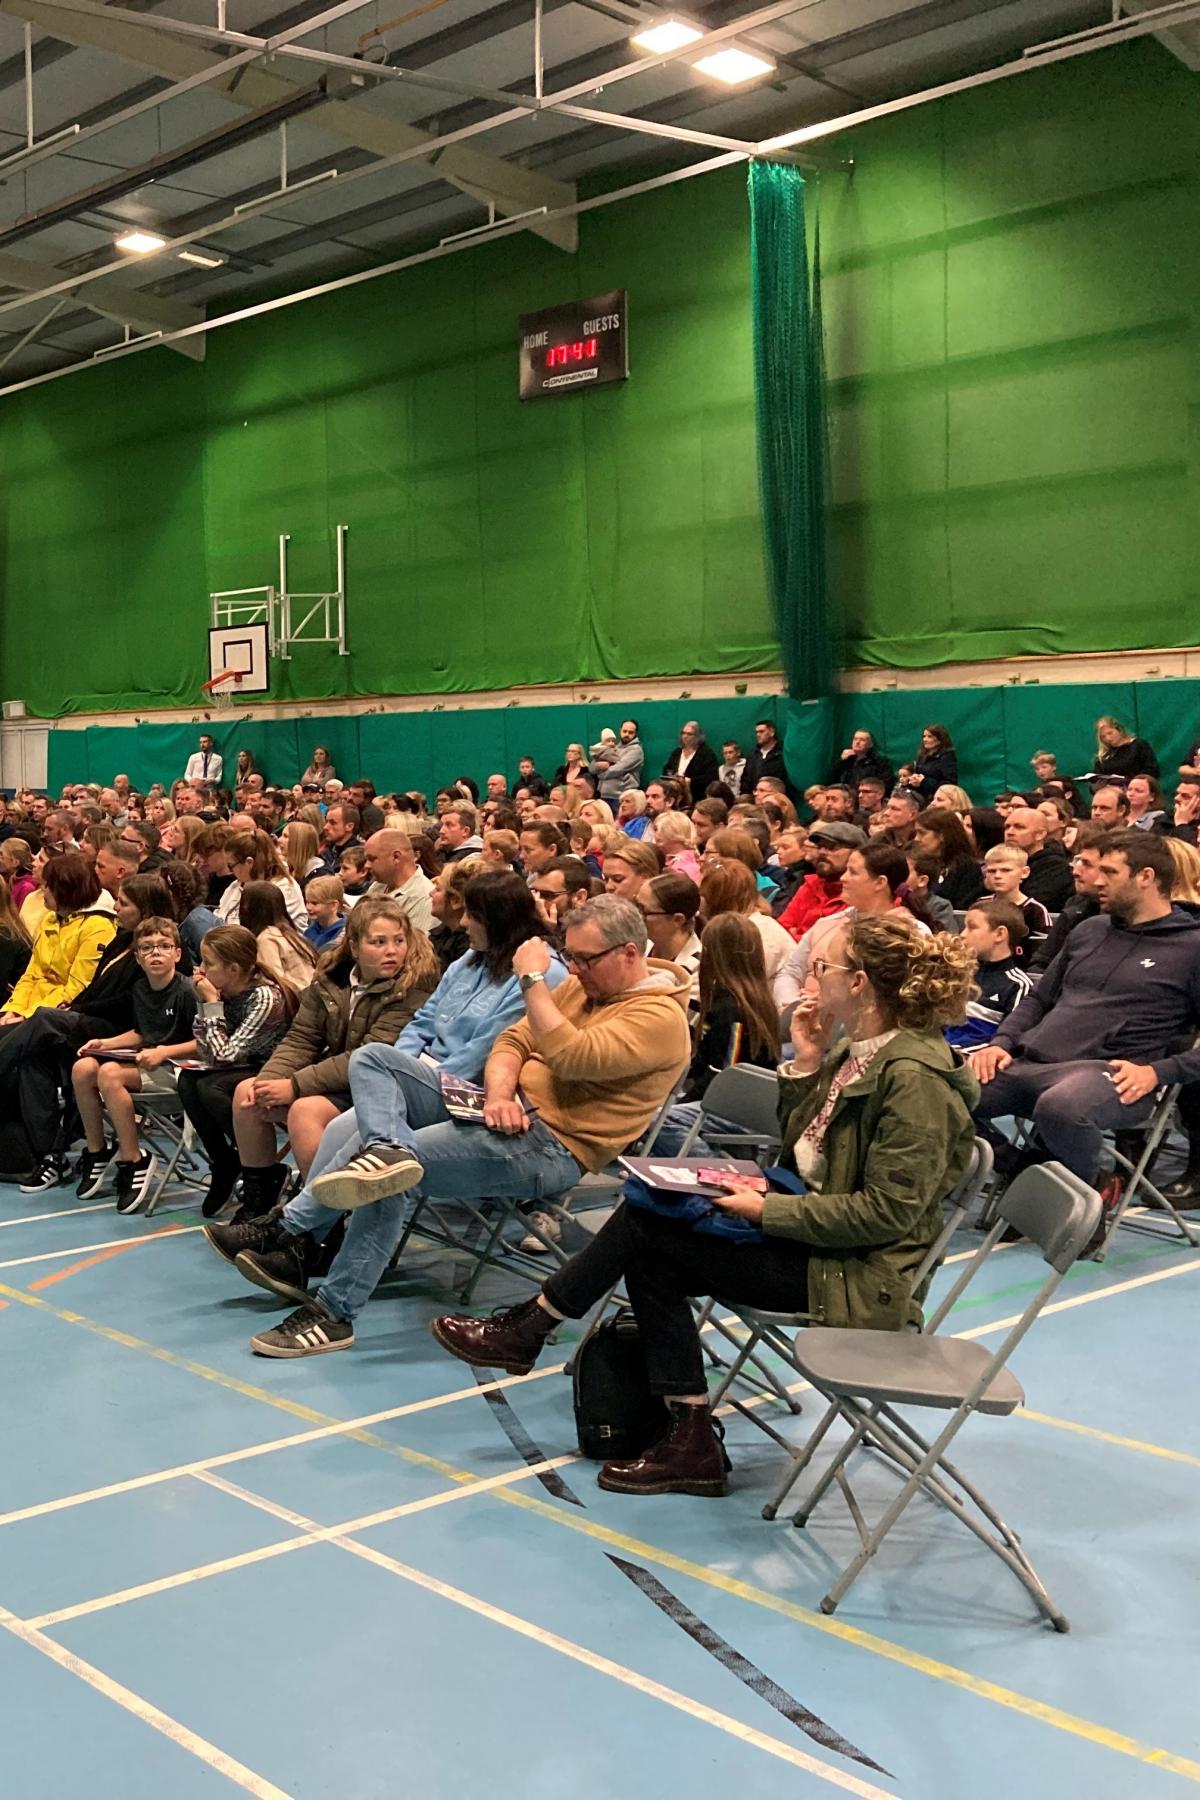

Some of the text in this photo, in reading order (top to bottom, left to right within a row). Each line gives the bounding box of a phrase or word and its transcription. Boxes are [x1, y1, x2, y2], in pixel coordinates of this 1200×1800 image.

[583, 314, 619, 335] GUESTS
[523, 331, 548, 349] HOME
[542, 369, 597, 387] CONTINENTAL
